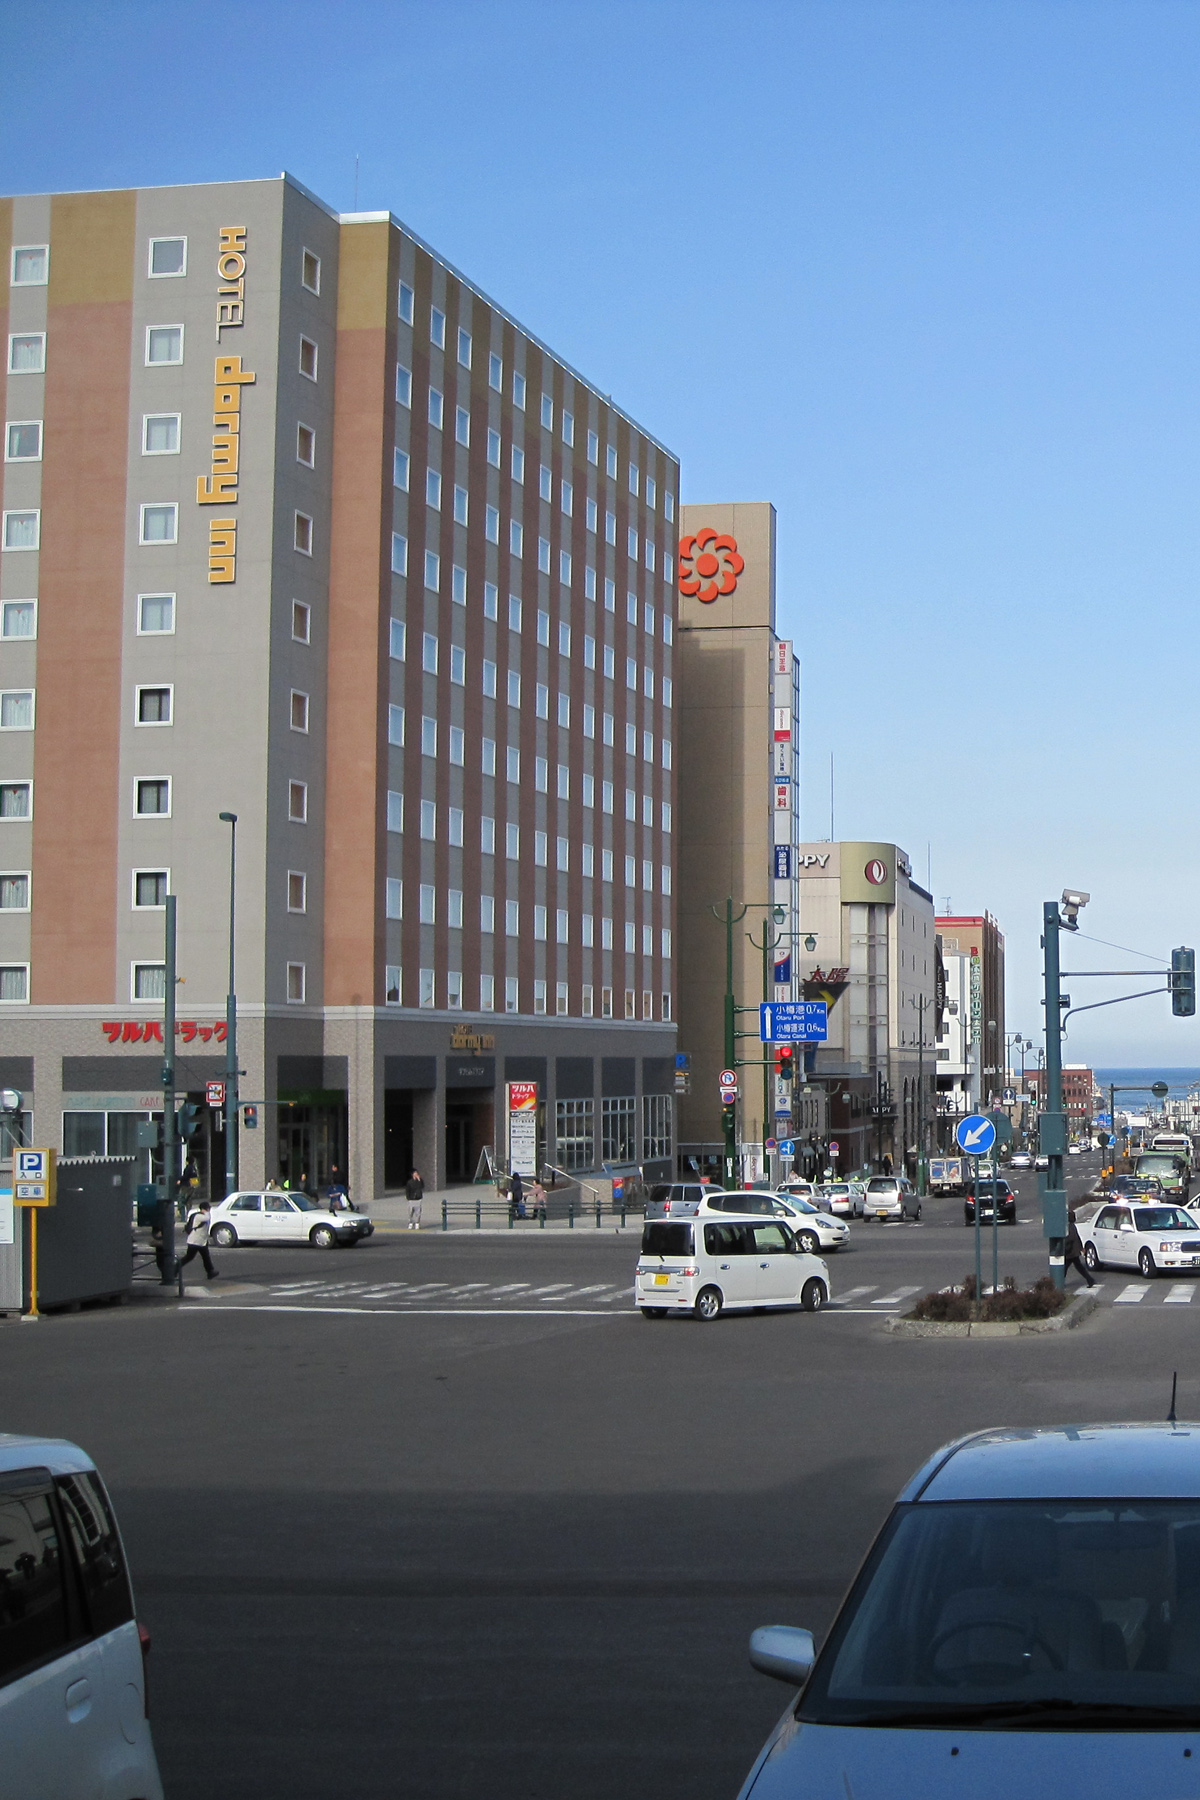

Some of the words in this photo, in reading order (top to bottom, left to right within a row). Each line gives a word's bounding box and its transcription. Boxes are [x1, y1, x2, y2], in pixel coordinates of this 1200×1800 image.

[217, 226, 246, 343] HOTEL
[196, 356, 255, 504] dormy
[208, 518, 236, 582] inn
[778, 786, 787, 807] 歯科
[776, 1005, 805, 1015] 小樽港
[776, 1023, 805, 1033] 小樽運河
[512, 1085, 535, 1093] ツルハ
[23, 1154, 39, 1170] P
